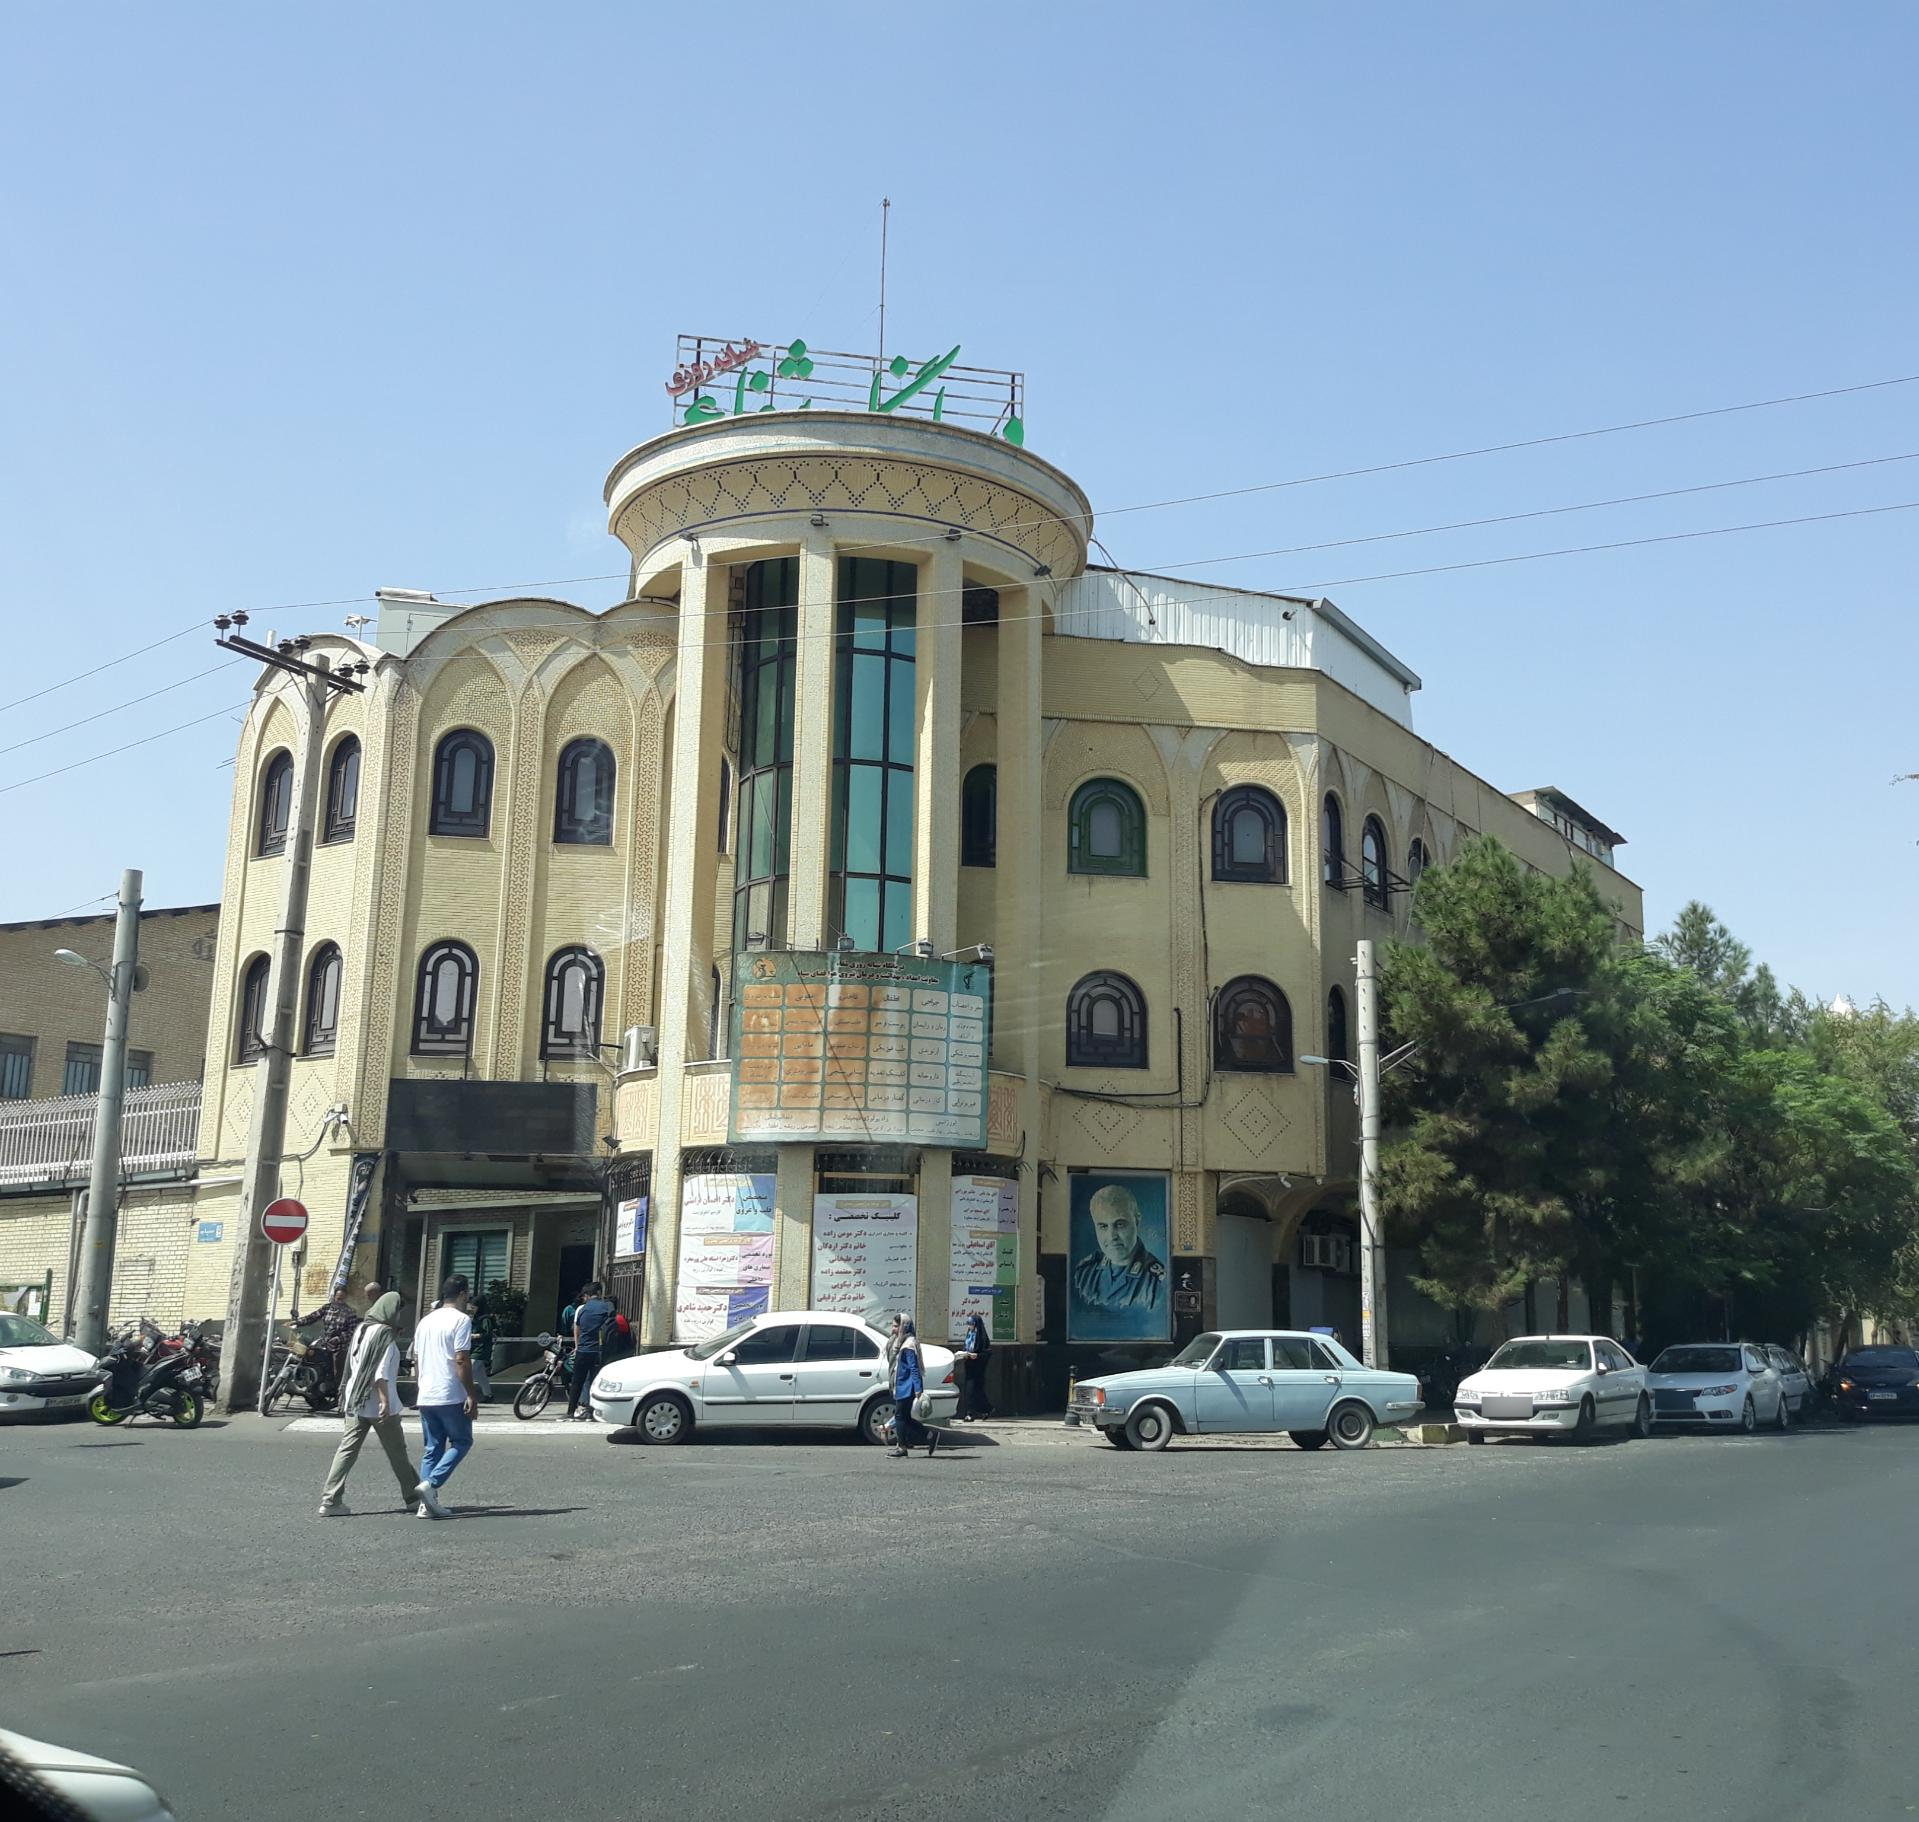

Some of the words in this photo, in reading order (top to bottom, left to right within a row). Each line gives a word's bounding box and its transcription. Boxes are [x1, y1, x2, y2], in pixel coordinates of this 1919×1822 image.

[715, 337, 760, 371] شبانه
[665, 360, 713, 396] روزی
[853, 1229, 867, 1238] دکتر
[840, 1242, 852, 1251] دکتر
[853, 1242, 866, 1251] خانم
[986, 1240, 995, 1250] آقای
[853, 1255, 866, 1264] دکتر
[853, 1268, 866, 1277] دکتر
[853, 1280, 866, 1289] دکتر
[838, 1293, 852, 1302] دکتر
[852, 1292, 865, 1302] خانم
[970, 1297, 980, 1305] خانم
[697, 1304, 712, 1314] حمید
[712, 1303, 727, 1314] دکتر
